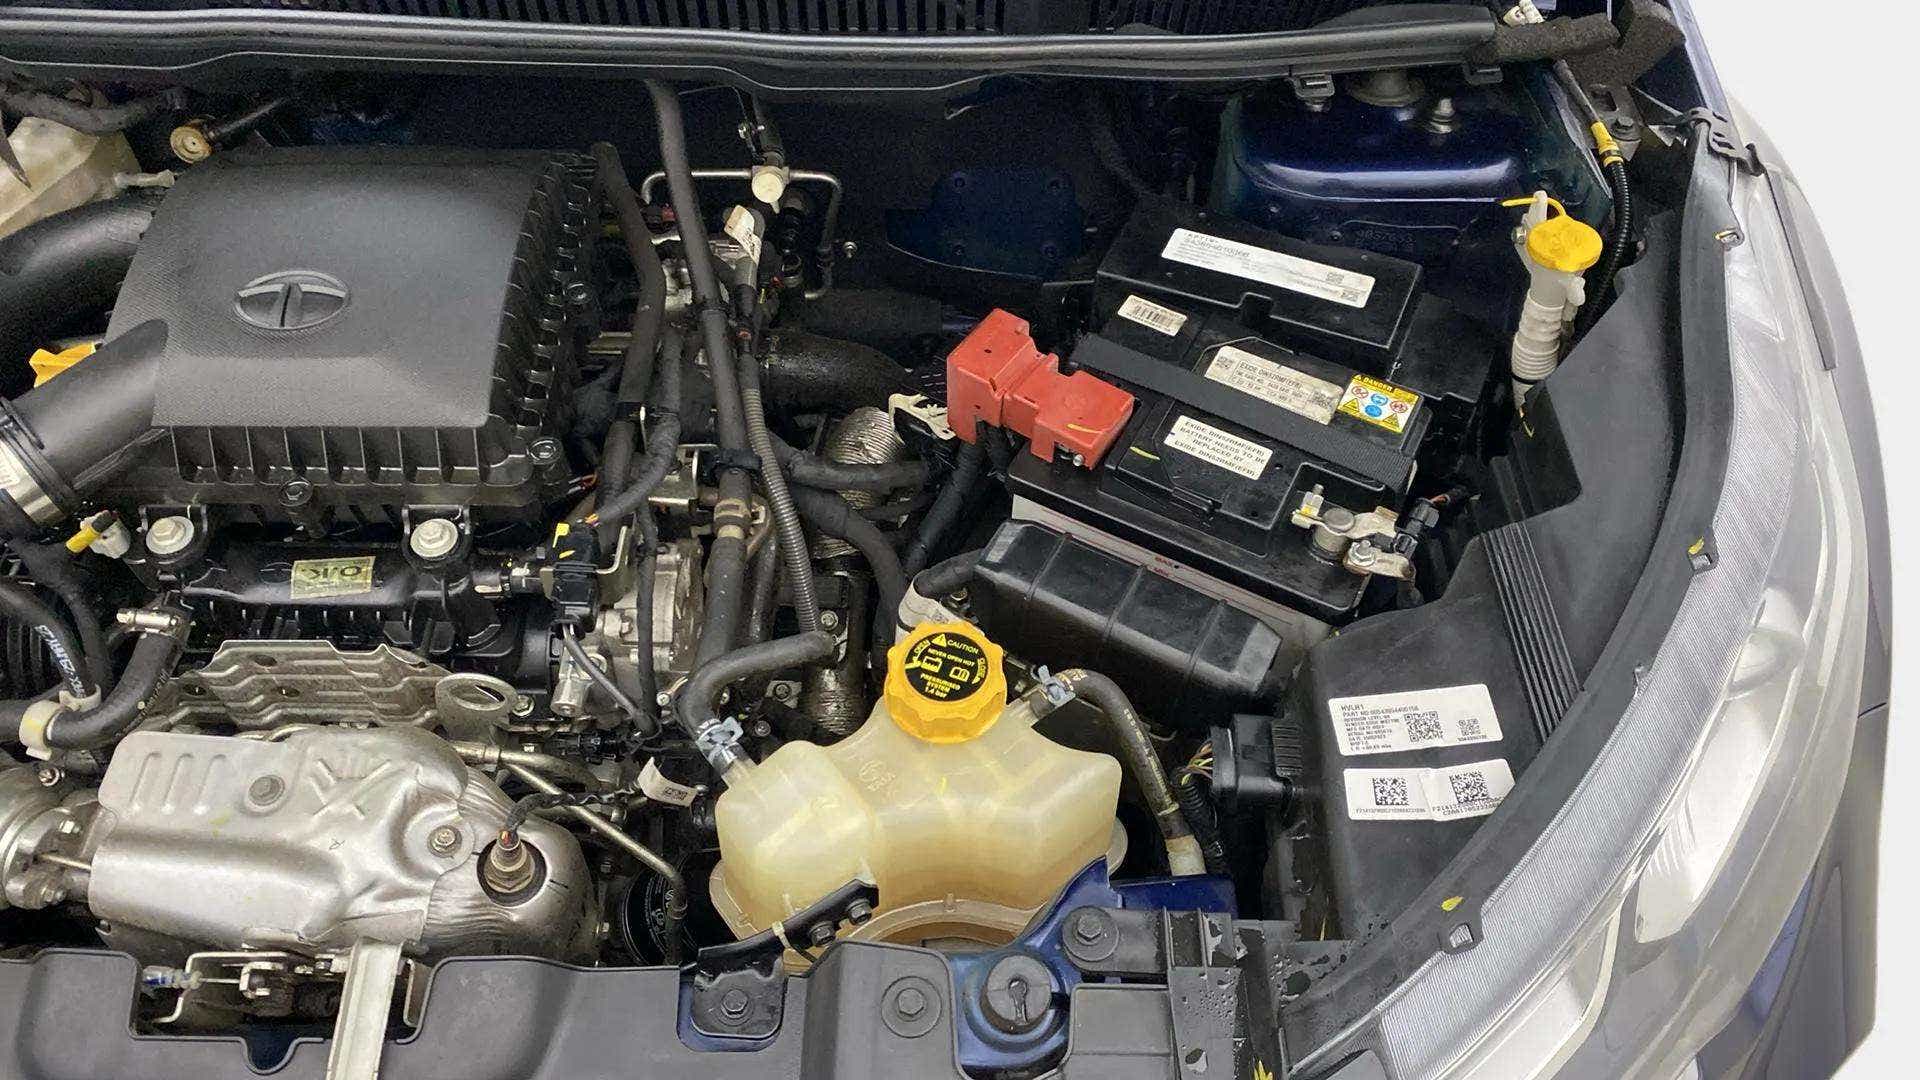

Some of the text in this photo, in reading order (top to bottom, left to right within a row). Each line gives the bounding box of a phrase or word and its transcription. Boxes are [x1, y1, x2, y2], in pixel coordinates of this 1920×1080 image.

[1240, 361, 1257, 374] EXIDE
[1363, 377, 1393, 392] DANGER
[1185, 421, 1208, 434] EXIDE
[1175, 440, 1197, 452] EXIDE
[1180, 426, 1265, 465] BATTERY NEEDS TO BE
[1193, 438, 1231, 457] REPLACED
[913, 640, 928, 654] OPEN
[947, 639, 979, 655] CAUTION
[928, 648, 947, 658] NEVER
[947, 654, 963, 663] OPEN
